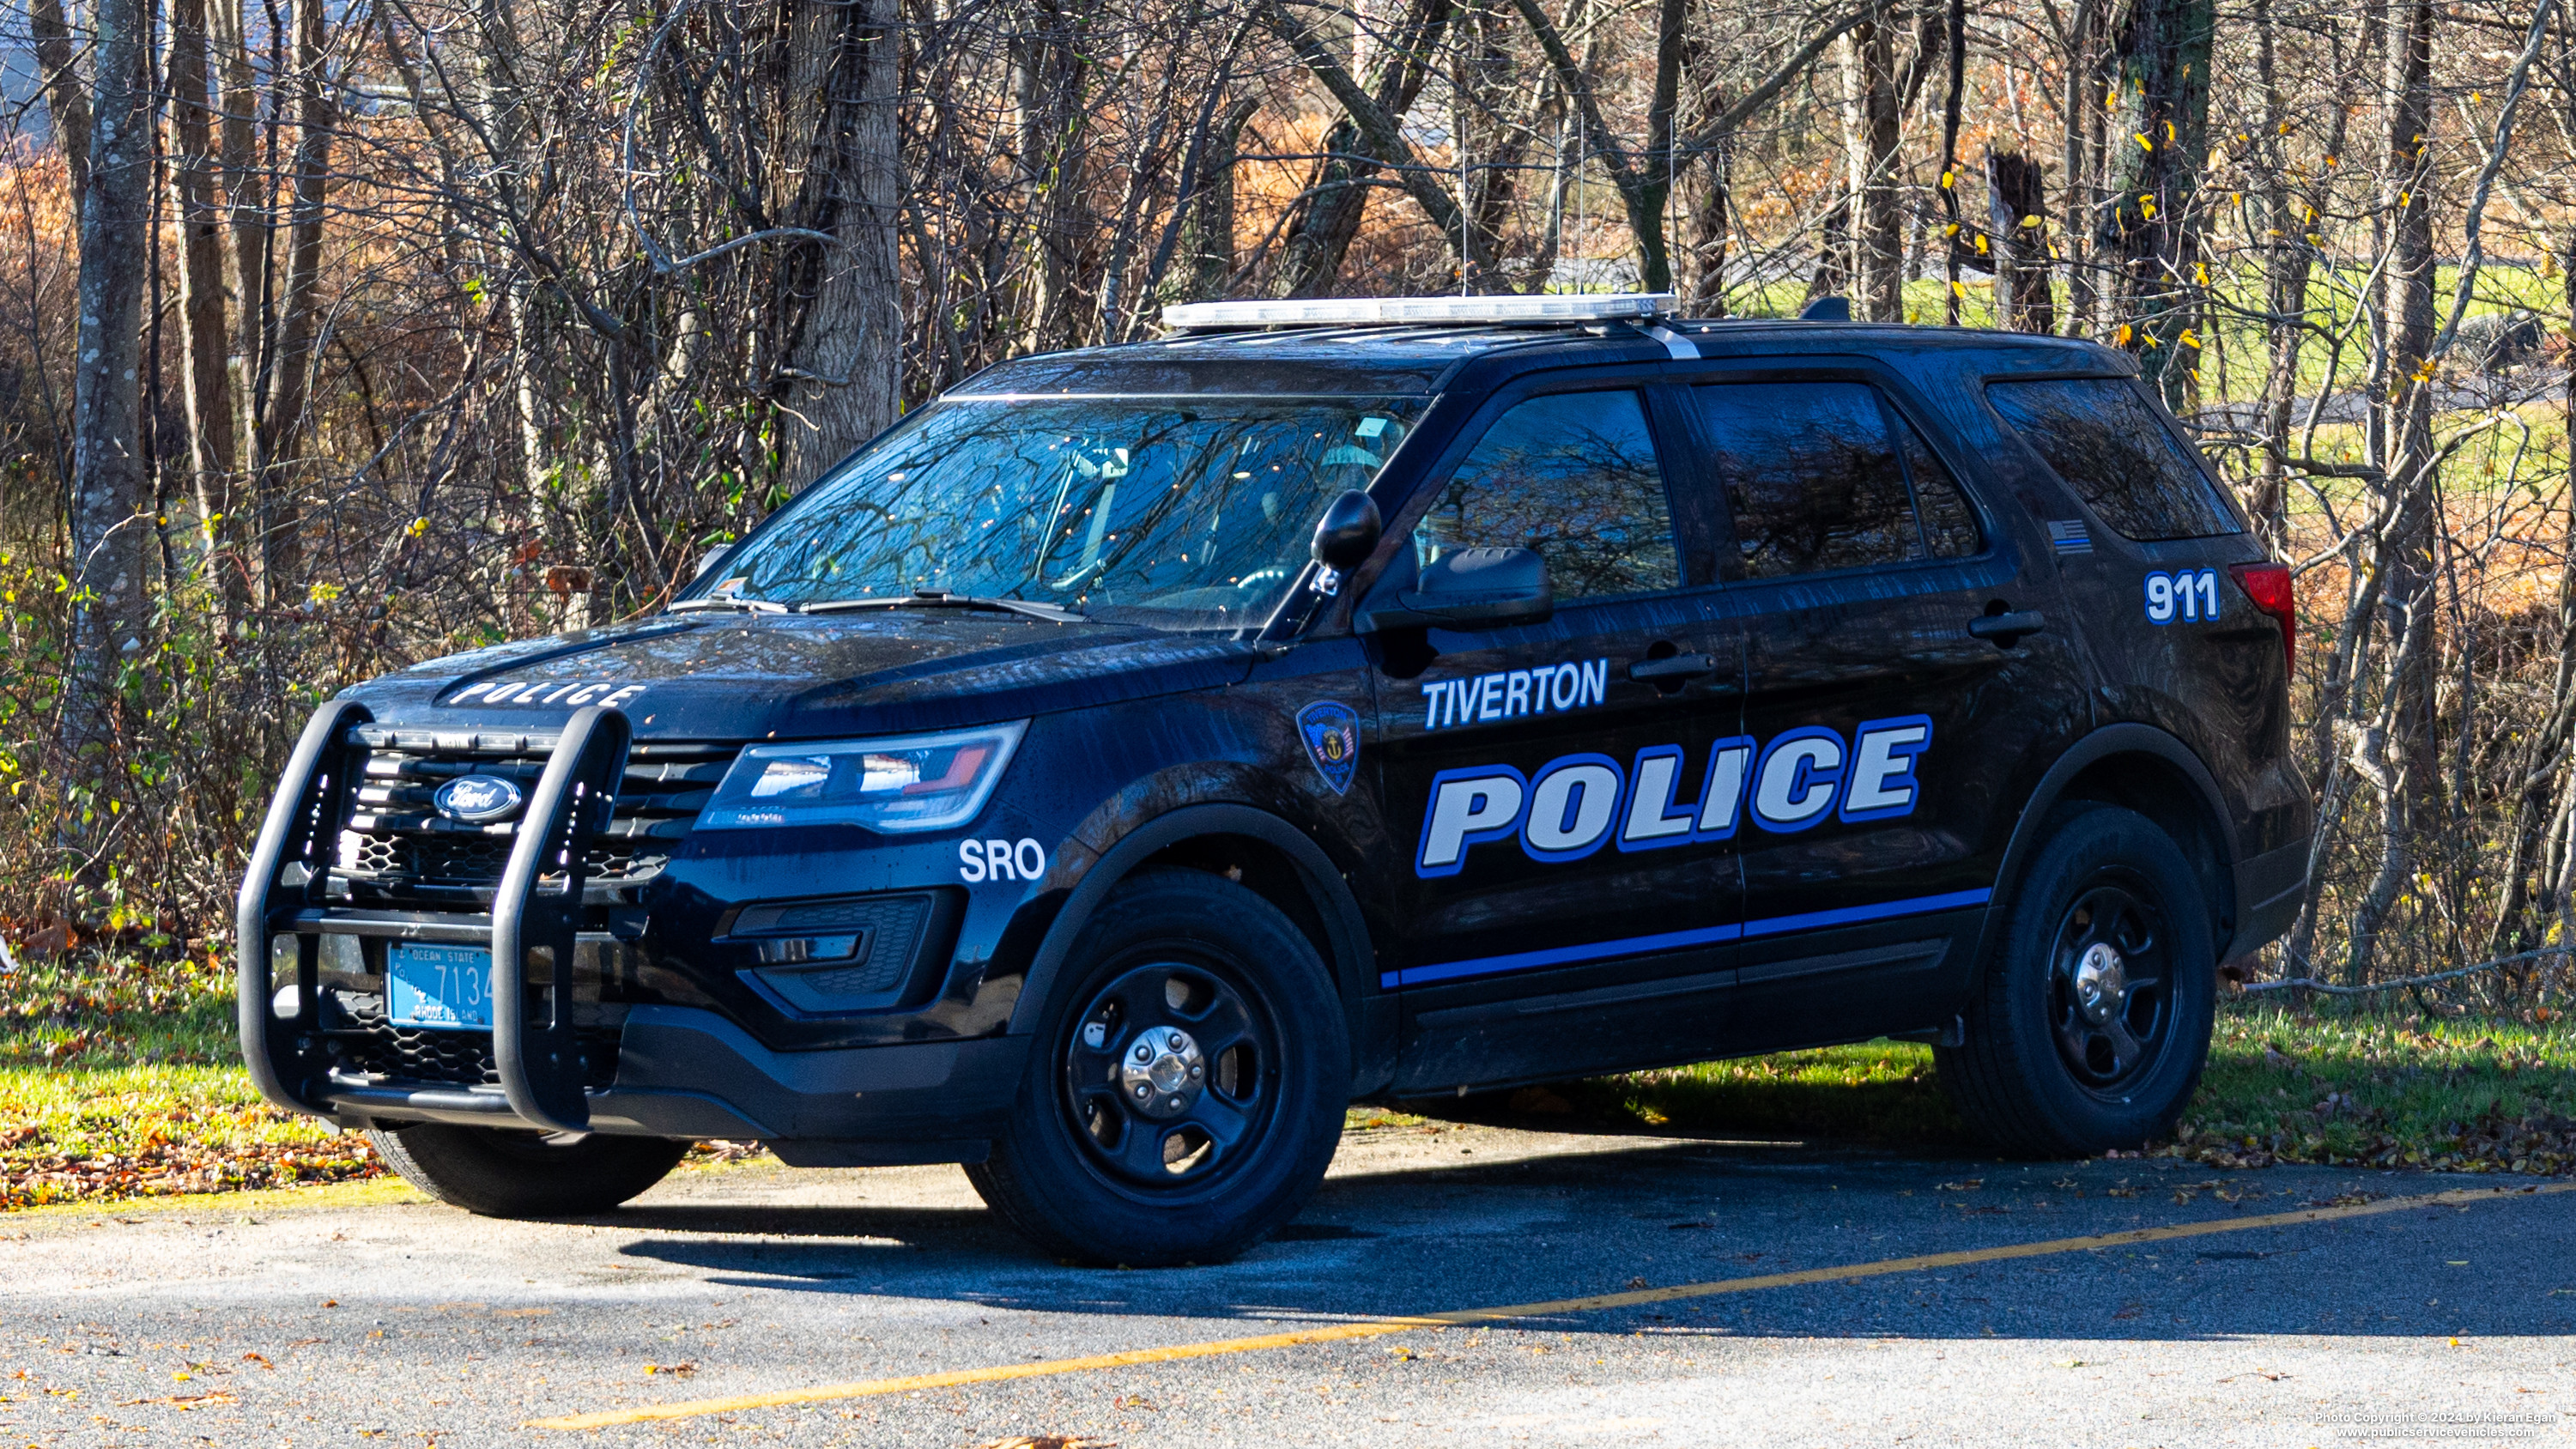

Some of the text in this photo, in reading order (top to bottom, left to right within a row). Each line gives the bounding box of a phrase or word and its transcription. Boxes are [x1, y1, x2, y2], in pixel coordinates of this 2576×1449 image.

[2146, 570, 2219, 623] 911
[449, 682, 646, 706] POLICE
[1422, 659, 1608, 729] TIVERTON
[447, 780, 498, 808] Ford
[1417, 718, 1931, 875] POLICE
[959, 837, 1046, 882] SRO
[412, 949, 475, 963] OCEAN STATE
[414, 1004, 477, 1022] RHODE ISLAND
